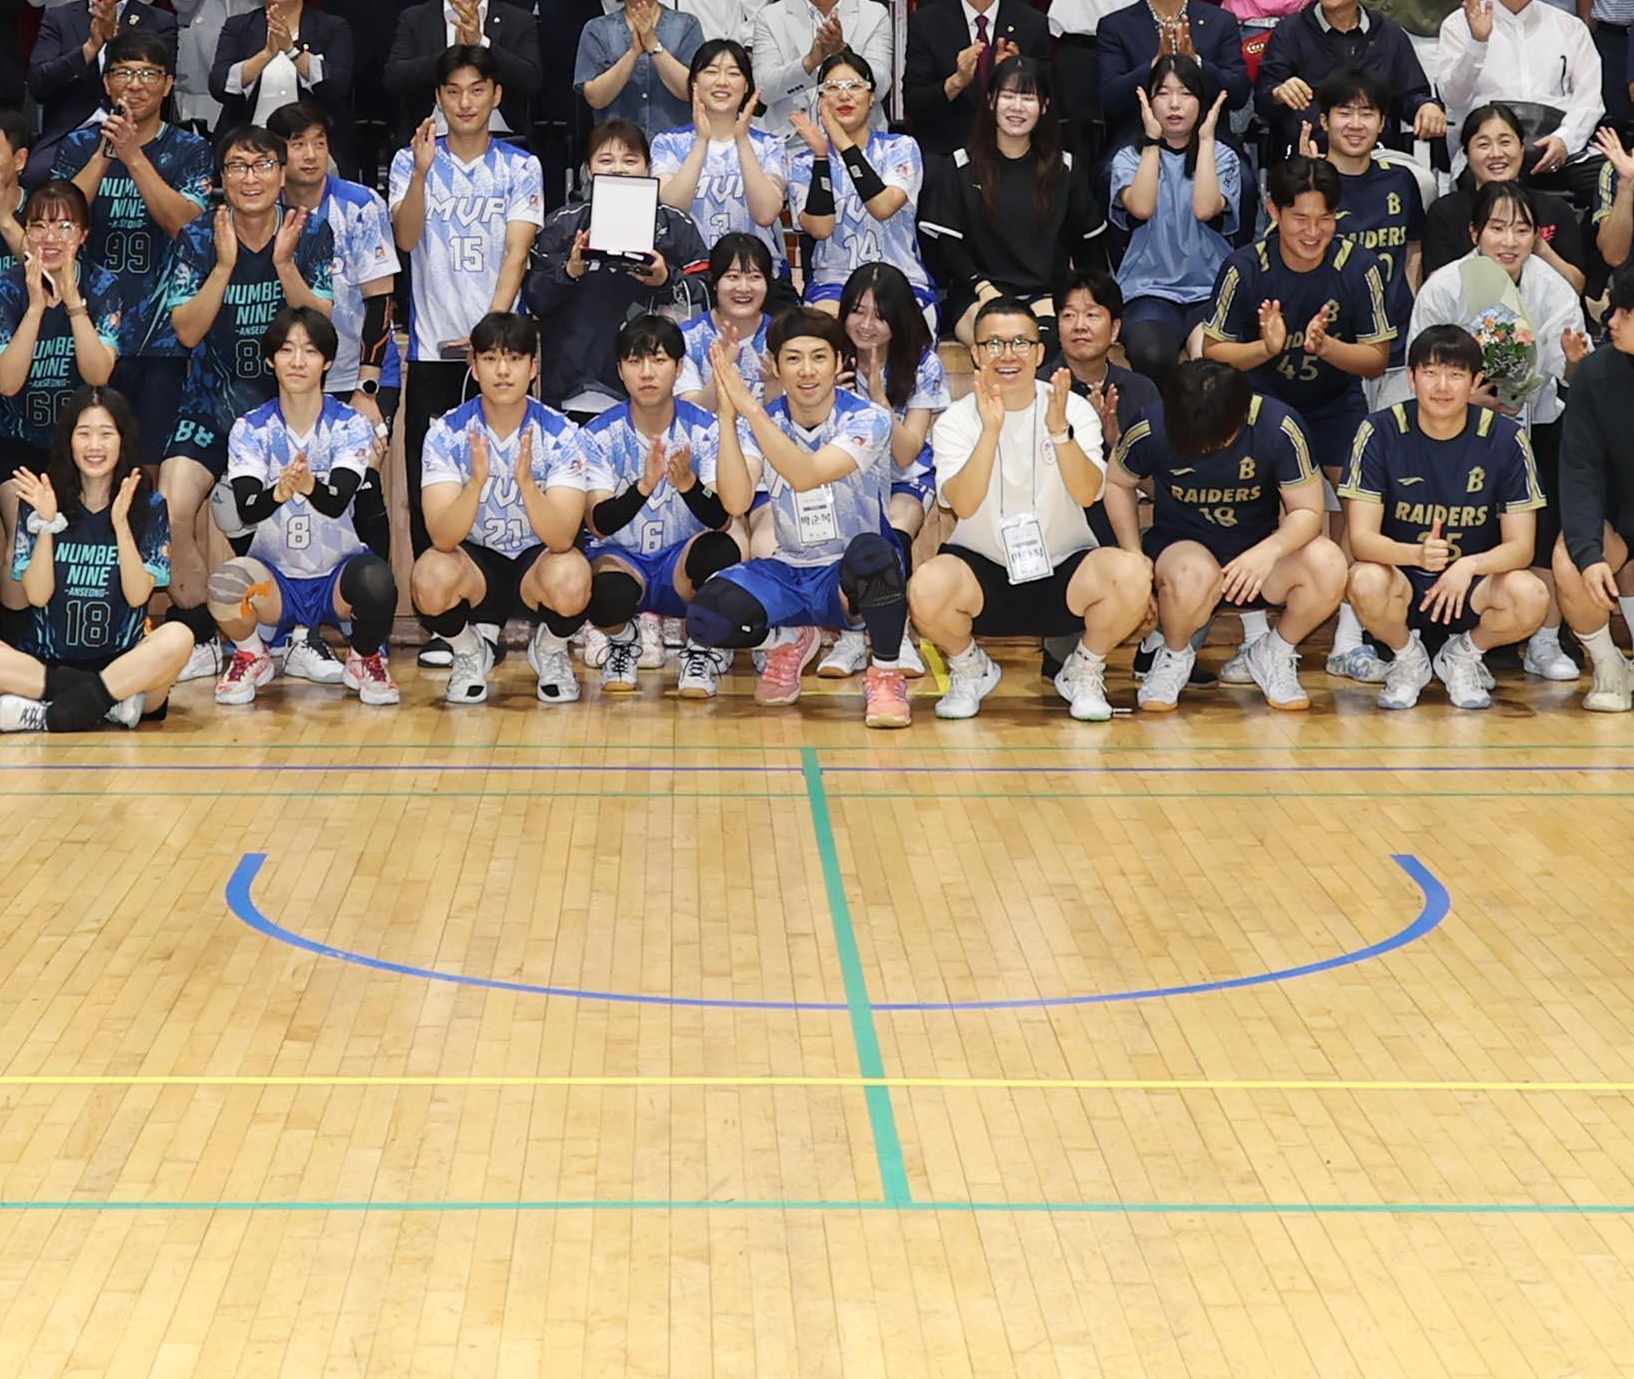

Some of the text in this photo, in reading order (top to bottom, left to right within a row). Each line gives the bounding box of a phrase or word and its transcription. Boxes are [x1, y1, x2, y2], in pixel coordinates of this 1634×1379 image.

[110, 199, 147, 218] NINE
[428, 195, 509, 228] MVP
[104, 231, 151, 273] 99
[450, 236, 483, 273] 15
[843, 230, 881, 271] 14
[236, 302, 278, 325] NINE
[30, 358, 70, 378] NINE
[1277, 355, 1319, 381] 45
[1171, 485, 1262, 505] RAIDERS
[1395, 501, 1488, 527] RAIDERS
[285, 514, 312, 551] 8
[482, 517, 524, 552] 21
[54, 542, 120, 565] NUMBE
[66, 563, 111, 586] NINE
[66, 600, 112, 648] 18
